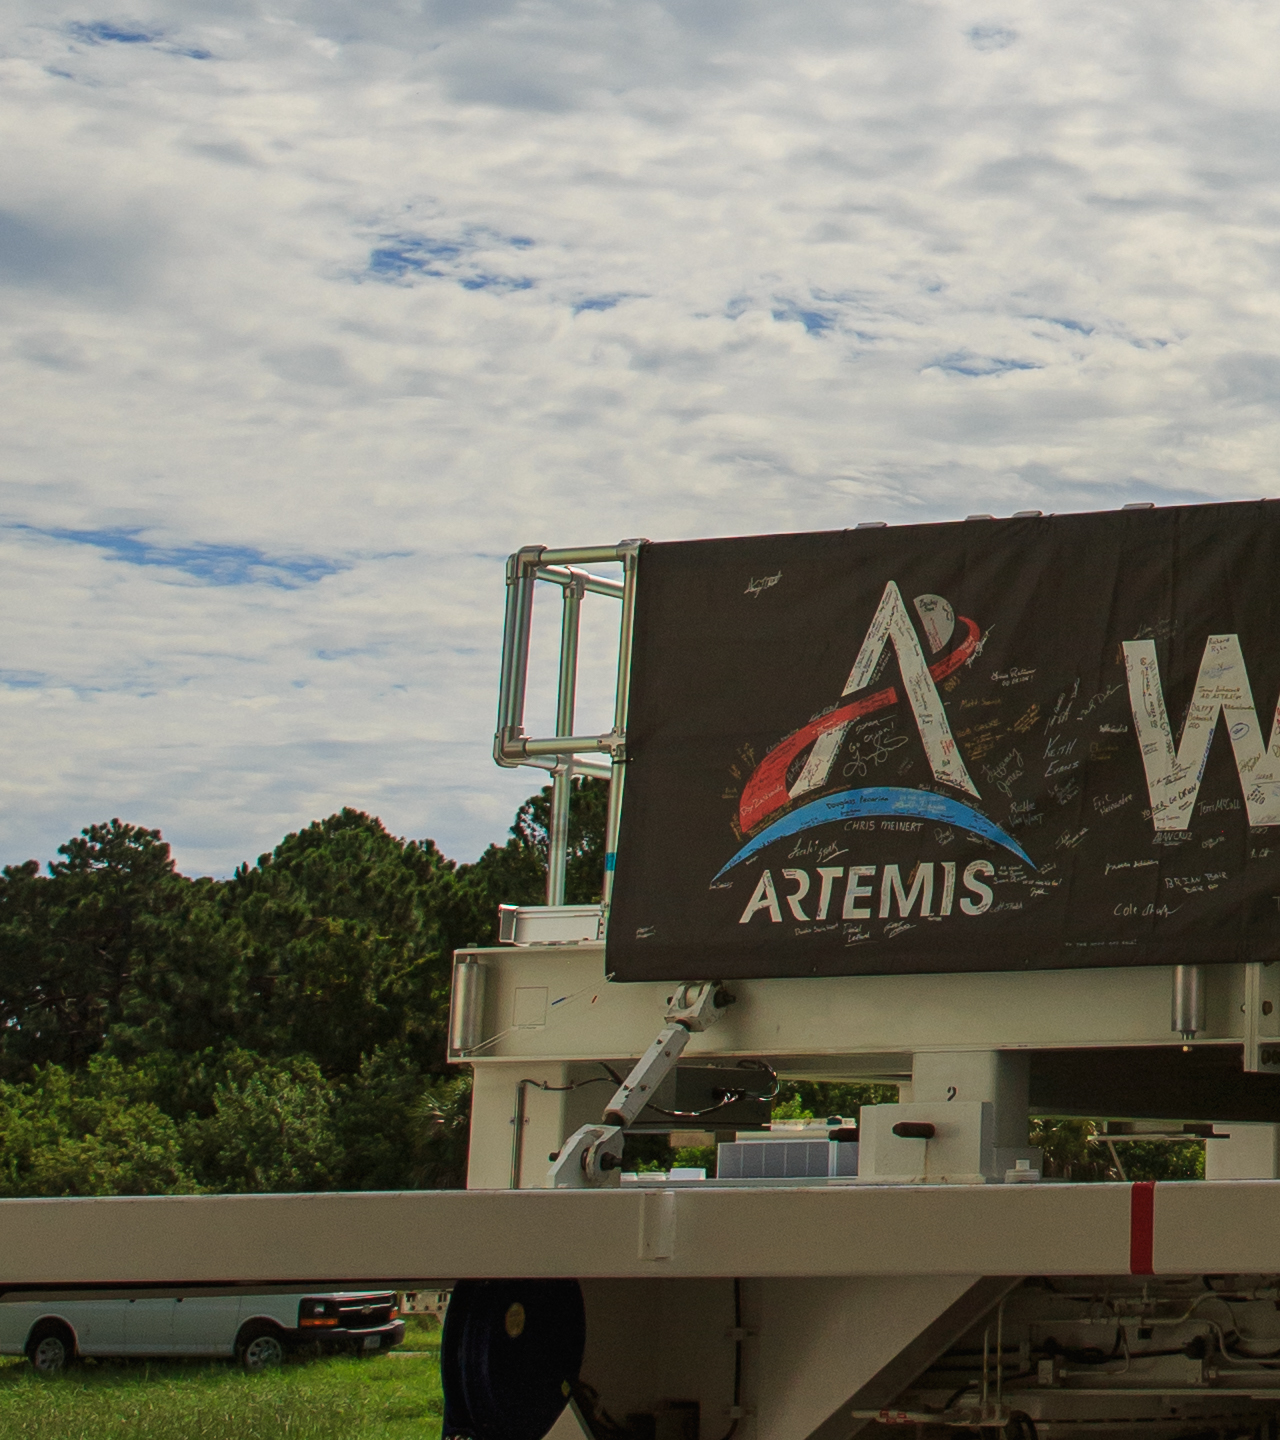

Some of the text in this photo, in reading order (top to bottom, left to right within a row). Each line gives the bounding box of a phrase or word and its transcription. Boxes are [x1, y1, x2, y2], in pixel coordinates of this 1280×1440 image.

[843, 820, 924, 833] CHRIS MEINERT
[738, 859, 995, 924] ARTEMIS
[1113, 903, 1138, 917] Cole
